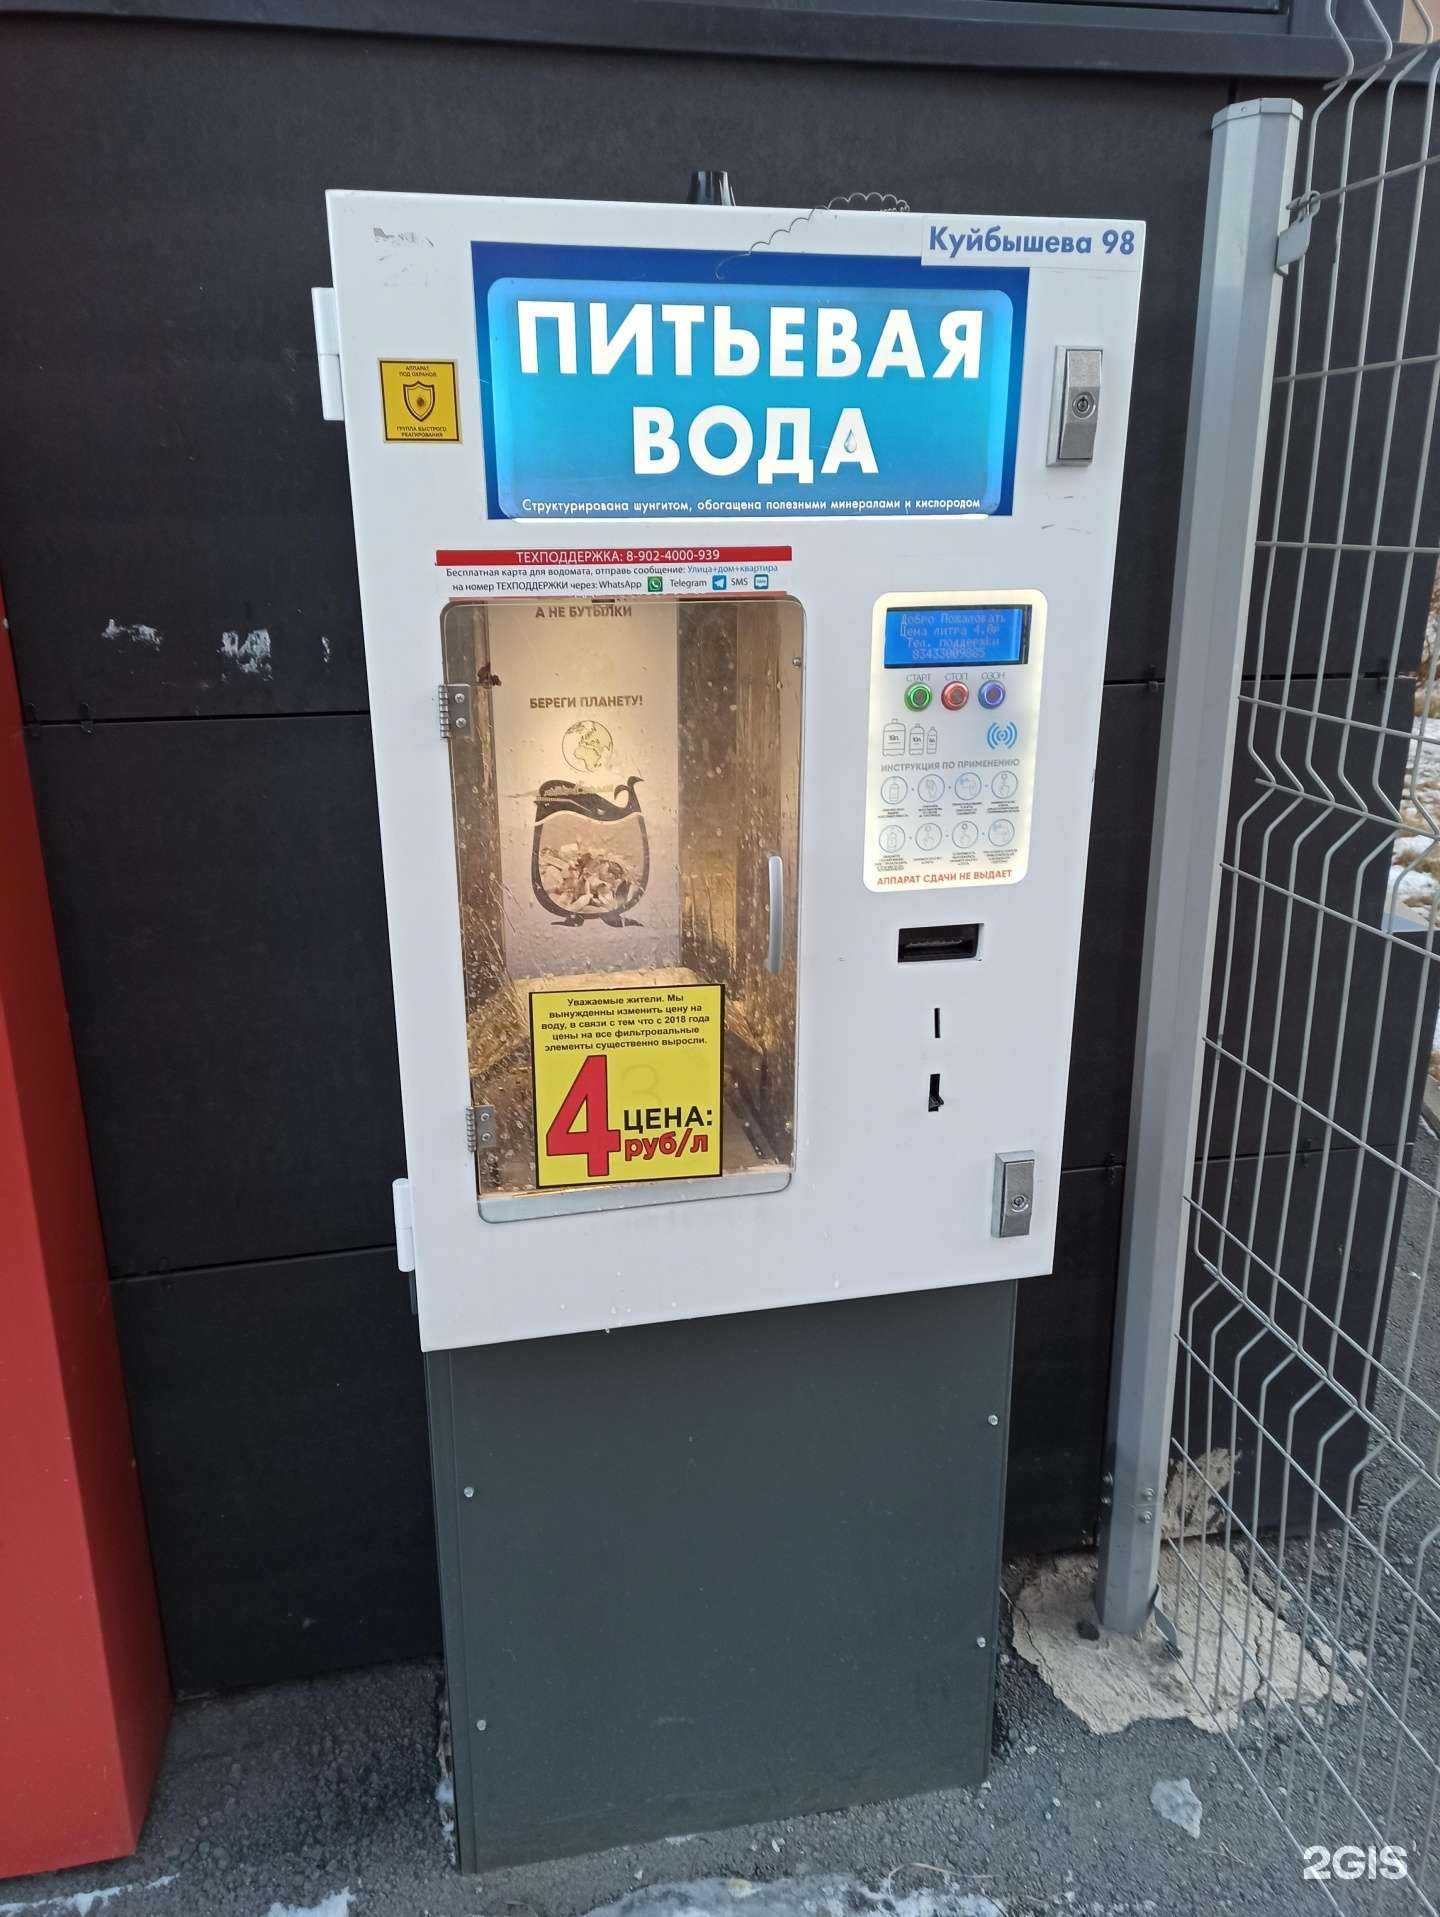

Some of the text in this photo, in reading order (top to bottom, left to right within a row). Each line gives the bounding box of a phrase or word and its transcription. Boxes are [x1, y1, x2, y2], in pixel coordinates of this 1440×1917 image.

[929, 225, 1135, 258] Куйбышева 98
[517, 299, 984, 379] ПИТЬЕВАЯ
[632, 405, 879, 484] ВОДА
[522, 498, 981, 513] Структурирована шунгитом, обогащена полезными минералами и кислородом
[516, 548, 720, 564] ТЕХПОДДЕРЖКА: 8-902-4000-939
[446, 564, 778, 578] Бесплатная карта для водомата, отправь сообщение: Улица+дом+квартира
[452, 583, 464, 591] на
[466, 582, 495, 592] номер
[496, 581, 569, 591] ТЕХПОДДЕРЖКИ
[570, 581, 597, 591] через:
[599, 579, 642, 590] WhatsApp
[669, 578, 708, 588] Telegram
[731, 576, 749, 586] SMS
[535, 606, 632, 618] А НЕ БУТЫЛКИ
[905, 674, 932, 683] СТАРТ
[944, 673, 969, 682] СТОП
[981, 671, 1006, 680] ОЗОН
[529, 694, 643, 708] БЕРЕГИ ПЛАНЕТУ!
[880, 758, 1020, 773] ИНСТРУКЦИЯ ПО ПРИМЕНЕНИЮ
[877, 869, 1013, 886] АППАРАТ СДАЧИ НЕ ВЫДАЕТ
[567, 993, 684, 1007] Уважаемые жители. Мы
[549, 1003, 703, 1019] вынужденны изменить цену на
[541, 1021, 567, 1031] воду,
[578, 1020, 608, 1029] связи
[609, 1020, 616, 1028] с
[617, 1019, 636, 1027] тем
[637, 1018, 655, 1026] что
[656, 1018, 663, 1026] с
[664, 1015, 686, 1025] 2018
[688, 1014, 710, 1025] года
[552, 1025, 700, 1043] цены на все фильтровальные
[545, 1037, 707, 1053] элементы существенно выросли.
[546, 1054, 622, 1177] 4
[623, 1105, 713, 1134] ЦЕНА:
[624, 1127, 709, 1162] руб/л
